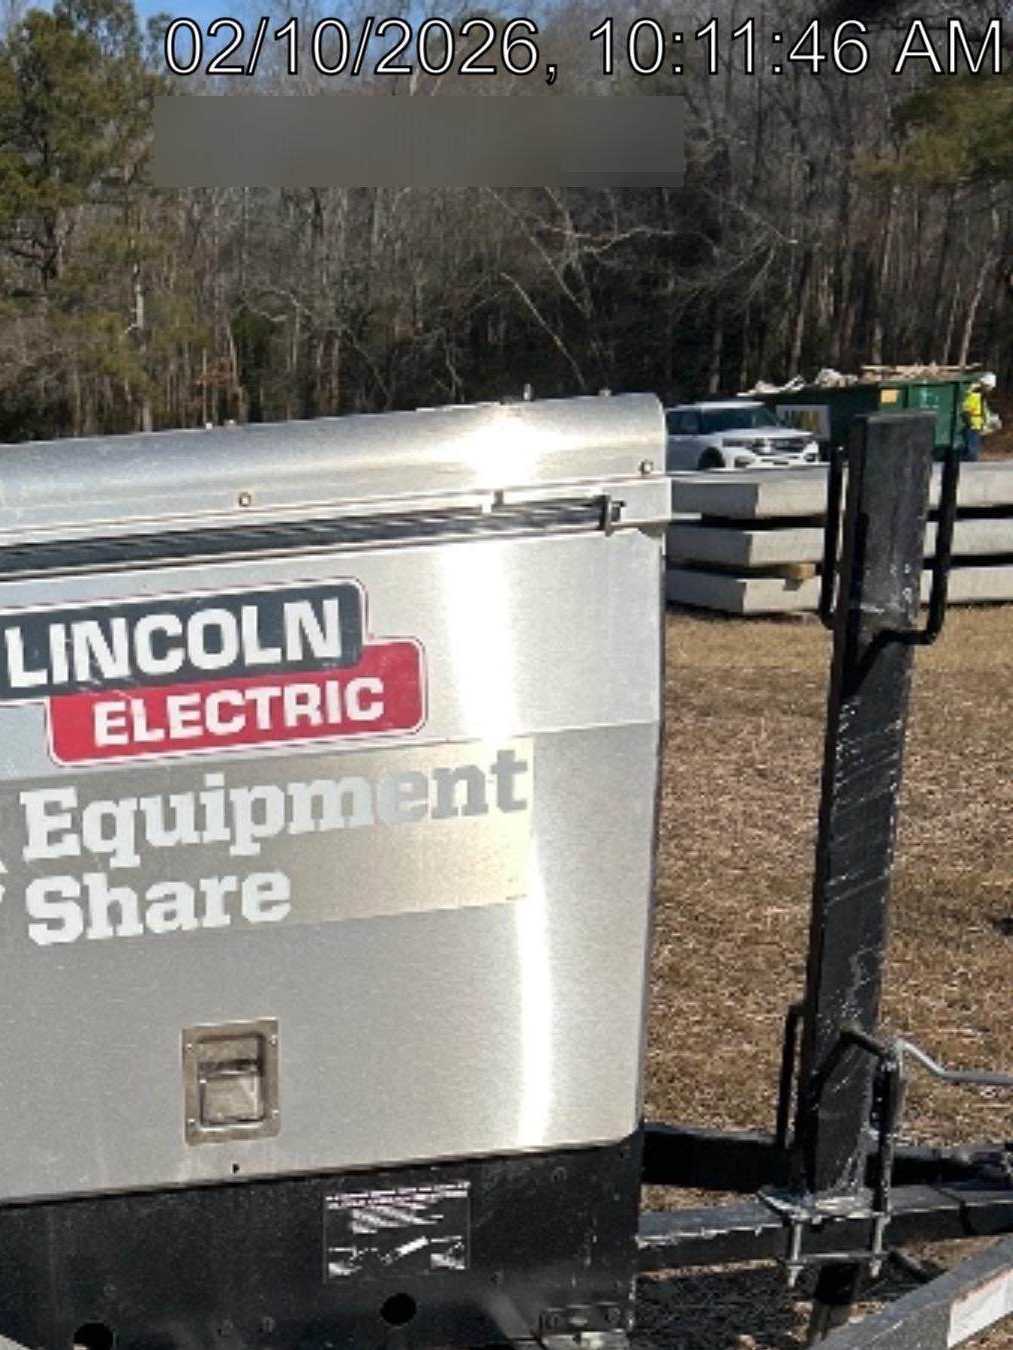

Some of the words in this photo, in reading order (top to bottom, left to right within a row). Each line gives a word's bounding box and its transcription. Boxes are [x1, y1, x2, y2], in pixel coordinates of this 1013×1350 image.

[4, 597, 342, 689] LINCOLN
[94, 677, 385, 747] ELECTRIC
[21, 748, 529, 869] Equipment
[26, 870, 292, 946] Share
